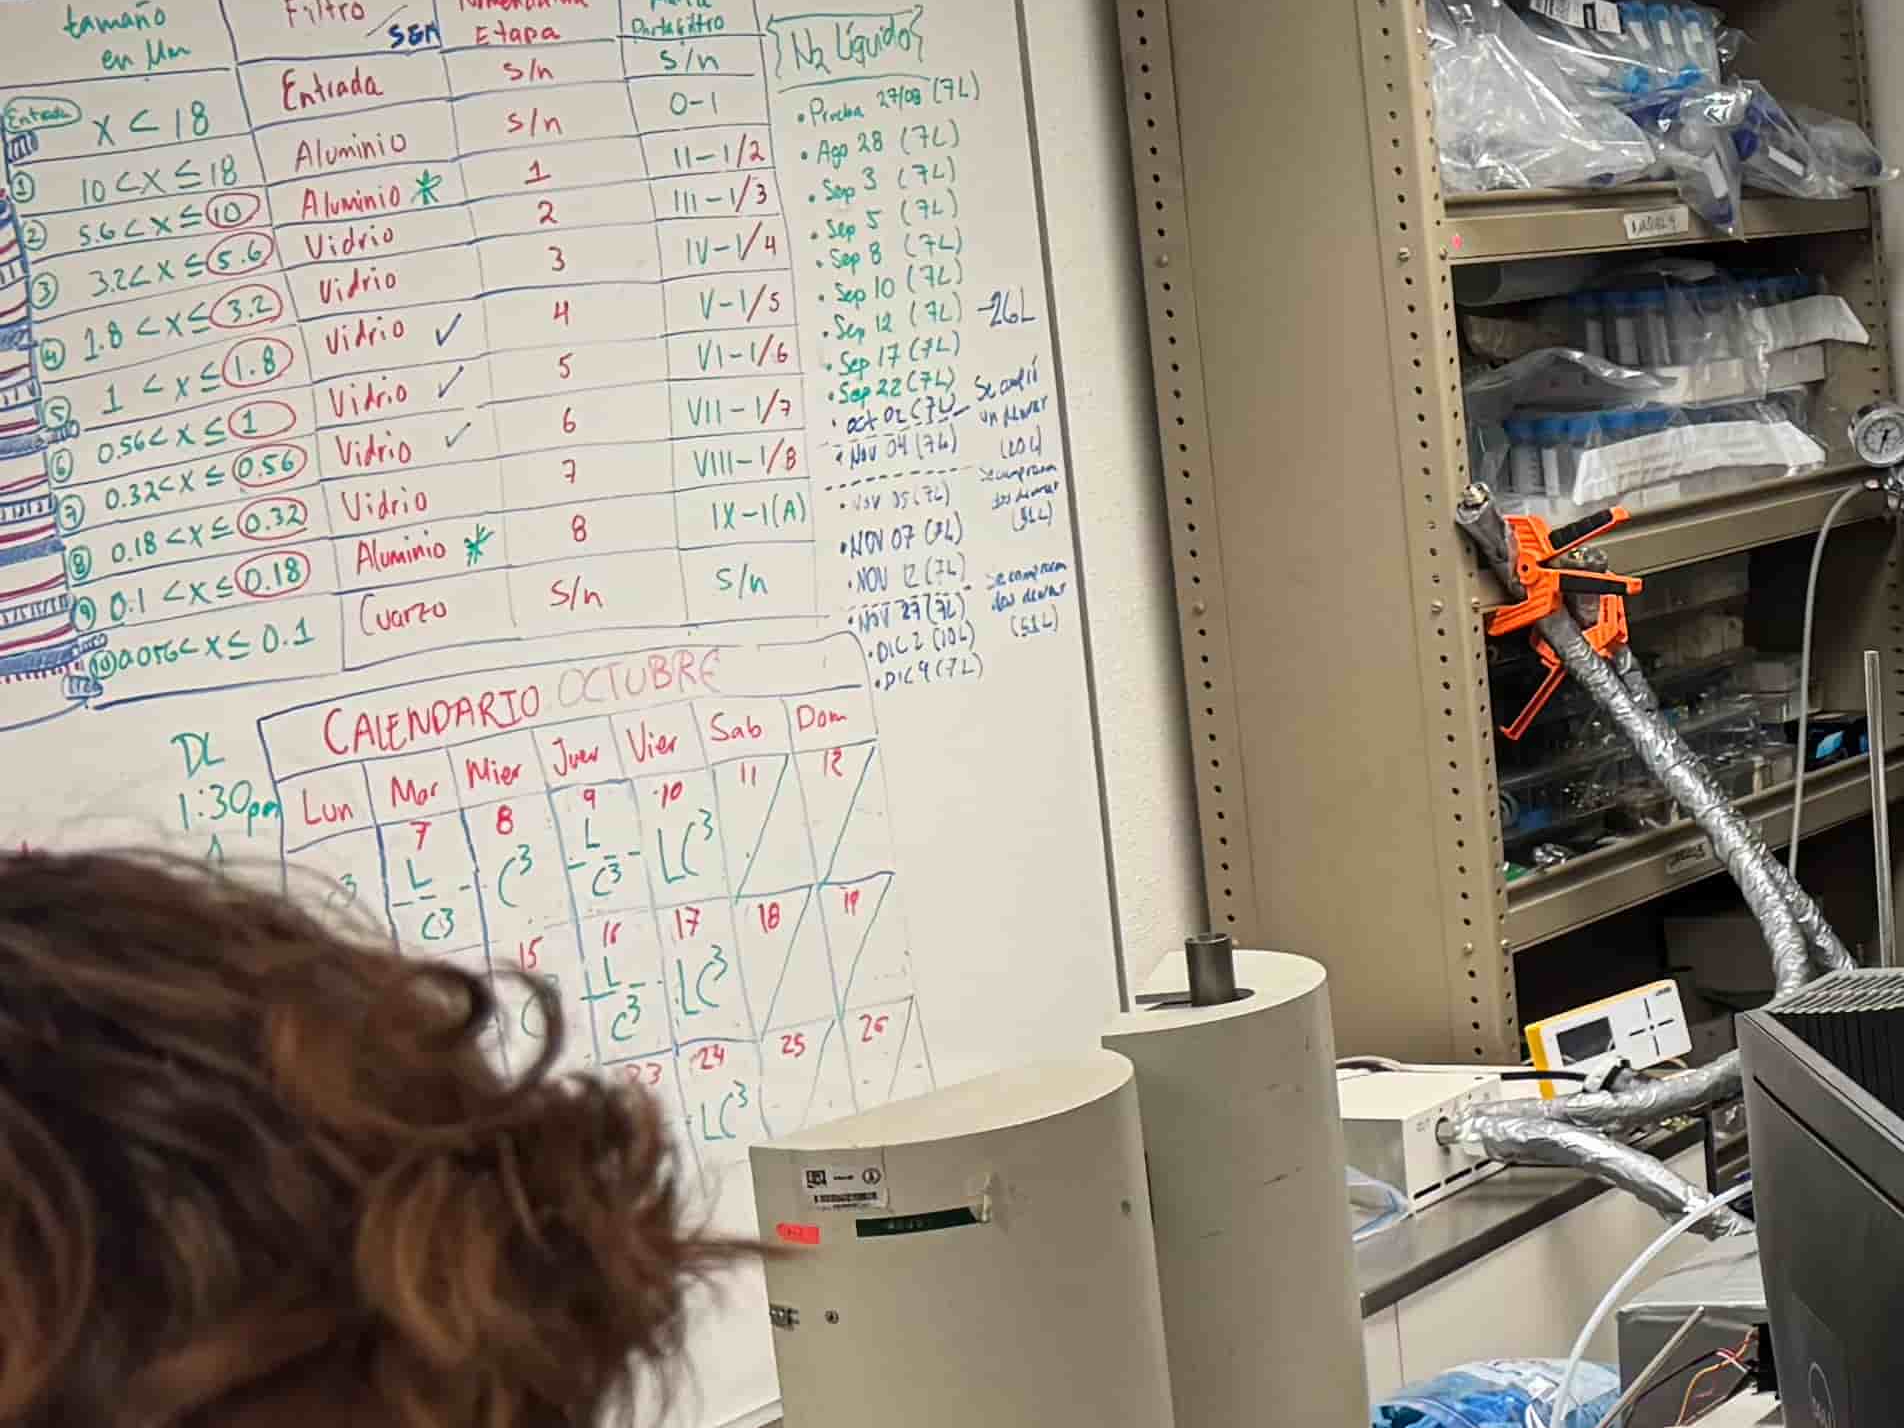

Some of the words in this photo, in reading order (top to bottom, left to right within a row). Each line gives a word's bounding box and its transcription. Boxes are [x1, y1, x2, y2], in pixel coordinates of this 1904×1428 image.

[64, 0, 167, 40] tamaño
[475, 19, 560, 45] Etapa
[101, 44, 134, 69] en
[281, 66, 384, 113] Entrada
[809, 97, 865, 127] Prueba
[294, 131, 408, 173] Aluminio
[816, 140, 849, 169] Ago
[858, 130, 883, 153] 28
[822, 179, 855, 205] Sep
[863, 167, 877, 191] 3
[301, 183, 402, 221] Aluminio
[537, 200, 559, 224] 2
[304, 223, 395, 261] Vidrio
[826, 218, 856, 244] Sep
[866, 210, 882, 230] 5
[548, 245, 566, 272] 3
[830, 247, 861, 275] Sep
[869, 242, 882, 265] 8
[319, 267, 397, 305] Vidrio
[835, 277, 867, 306] Sep
[874, 275, 896, 300] 10
[553, 300, 570, 325] 4
[833, 314, 866, 343] Sep
[875, 312, 894, 334] 12
[325, 317, 405, 356] Vidrio
[559, 352, 574, 380] 5
[840, 350, 871, 376] Sep
[879, 343, 900, 369] 17
[329, 381, 408, 419] Vidrio
[837, 375, 872, 404] Sep
[876, 377, 902, 397] 22
[561, 406, 577, 434] 6
[335, 430, 413, 467] Vidrio
[561, 459, 577, 484] 7
[340, 484, 429, 523] Vidrio
[571, 514, 588, 542] 8
[891, 524, 916, 549] 07
[356, 530, 447, 575] Aluminio
[359, 593, 447, 638] Cuarzo
[900, 600, 922, 622] 27
[323, 684, 541, 756] CALENDARIO
[557, 646, 721, 708] OCTUBRE
[710, 711, 763, 743] Sab
[796, 703, 848, 734] Dom
[626, 720, 680, 762] Vier
[740, 762, 757, 787] 11
[824, 746, 843, 777] 12
[302, 788, 354, 826] Lun
[390, 776, 440, 809] Mar
[583, 788, 597, 810] 9
[661, 781, 684, 810] 10
[496, 805, 514, 836] 8
[410, 821, 431, 852] 7
[675, 905, 701, 941] 17
[758, 900, 781, 934] 18
[519, 936, 544, 971] 15
[779, 1032, 807, 1056] 25
[858, 1015, 890, 1043] 26
[698, 1044, 727, 1071] 24
